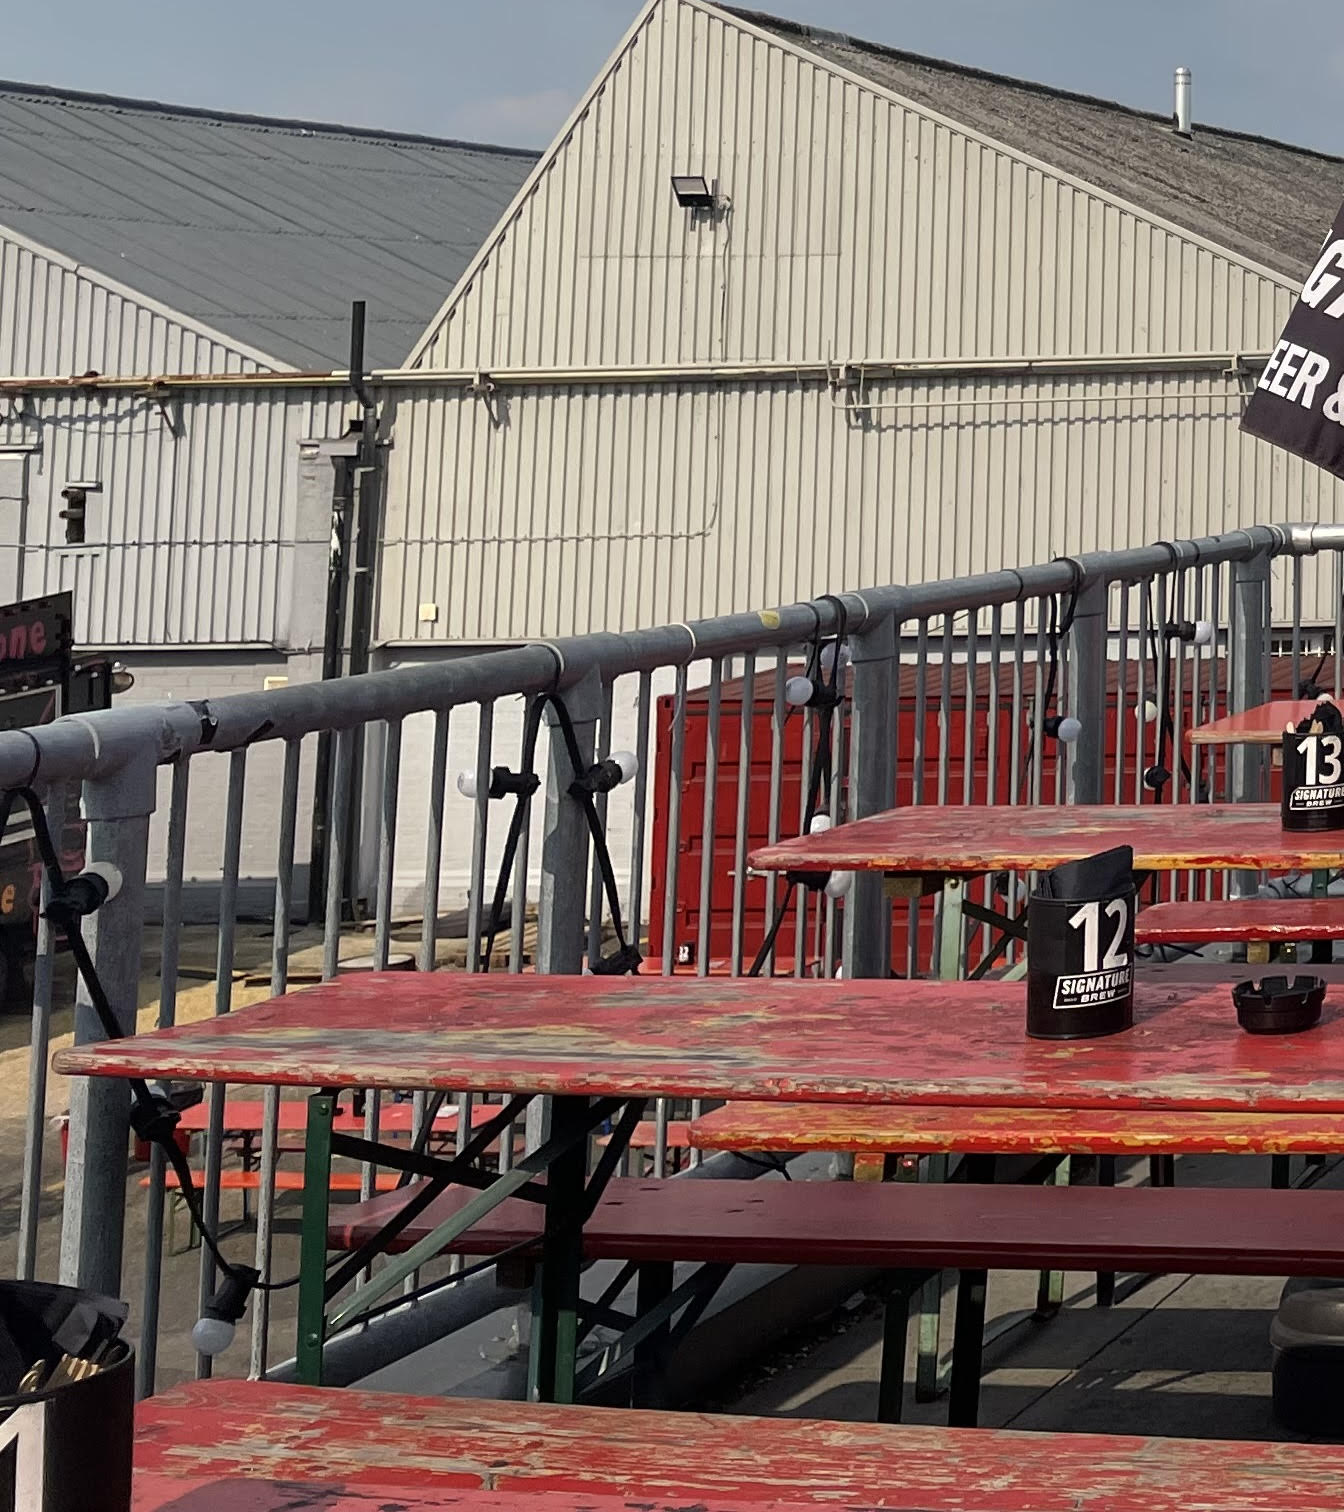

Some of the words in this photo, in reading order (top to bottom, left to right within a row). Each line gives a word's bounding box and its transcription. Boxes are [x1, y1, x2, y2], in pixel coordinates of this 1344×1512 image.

[1296, 735, 1342, 785] 13
[1306, 799, 1333, 808] BREW
[1068, 898, 1128, 972] 12
[1061, 968, 1130, 995] SIGNATURE
[1080, 989, 1116, 1003] BREW
